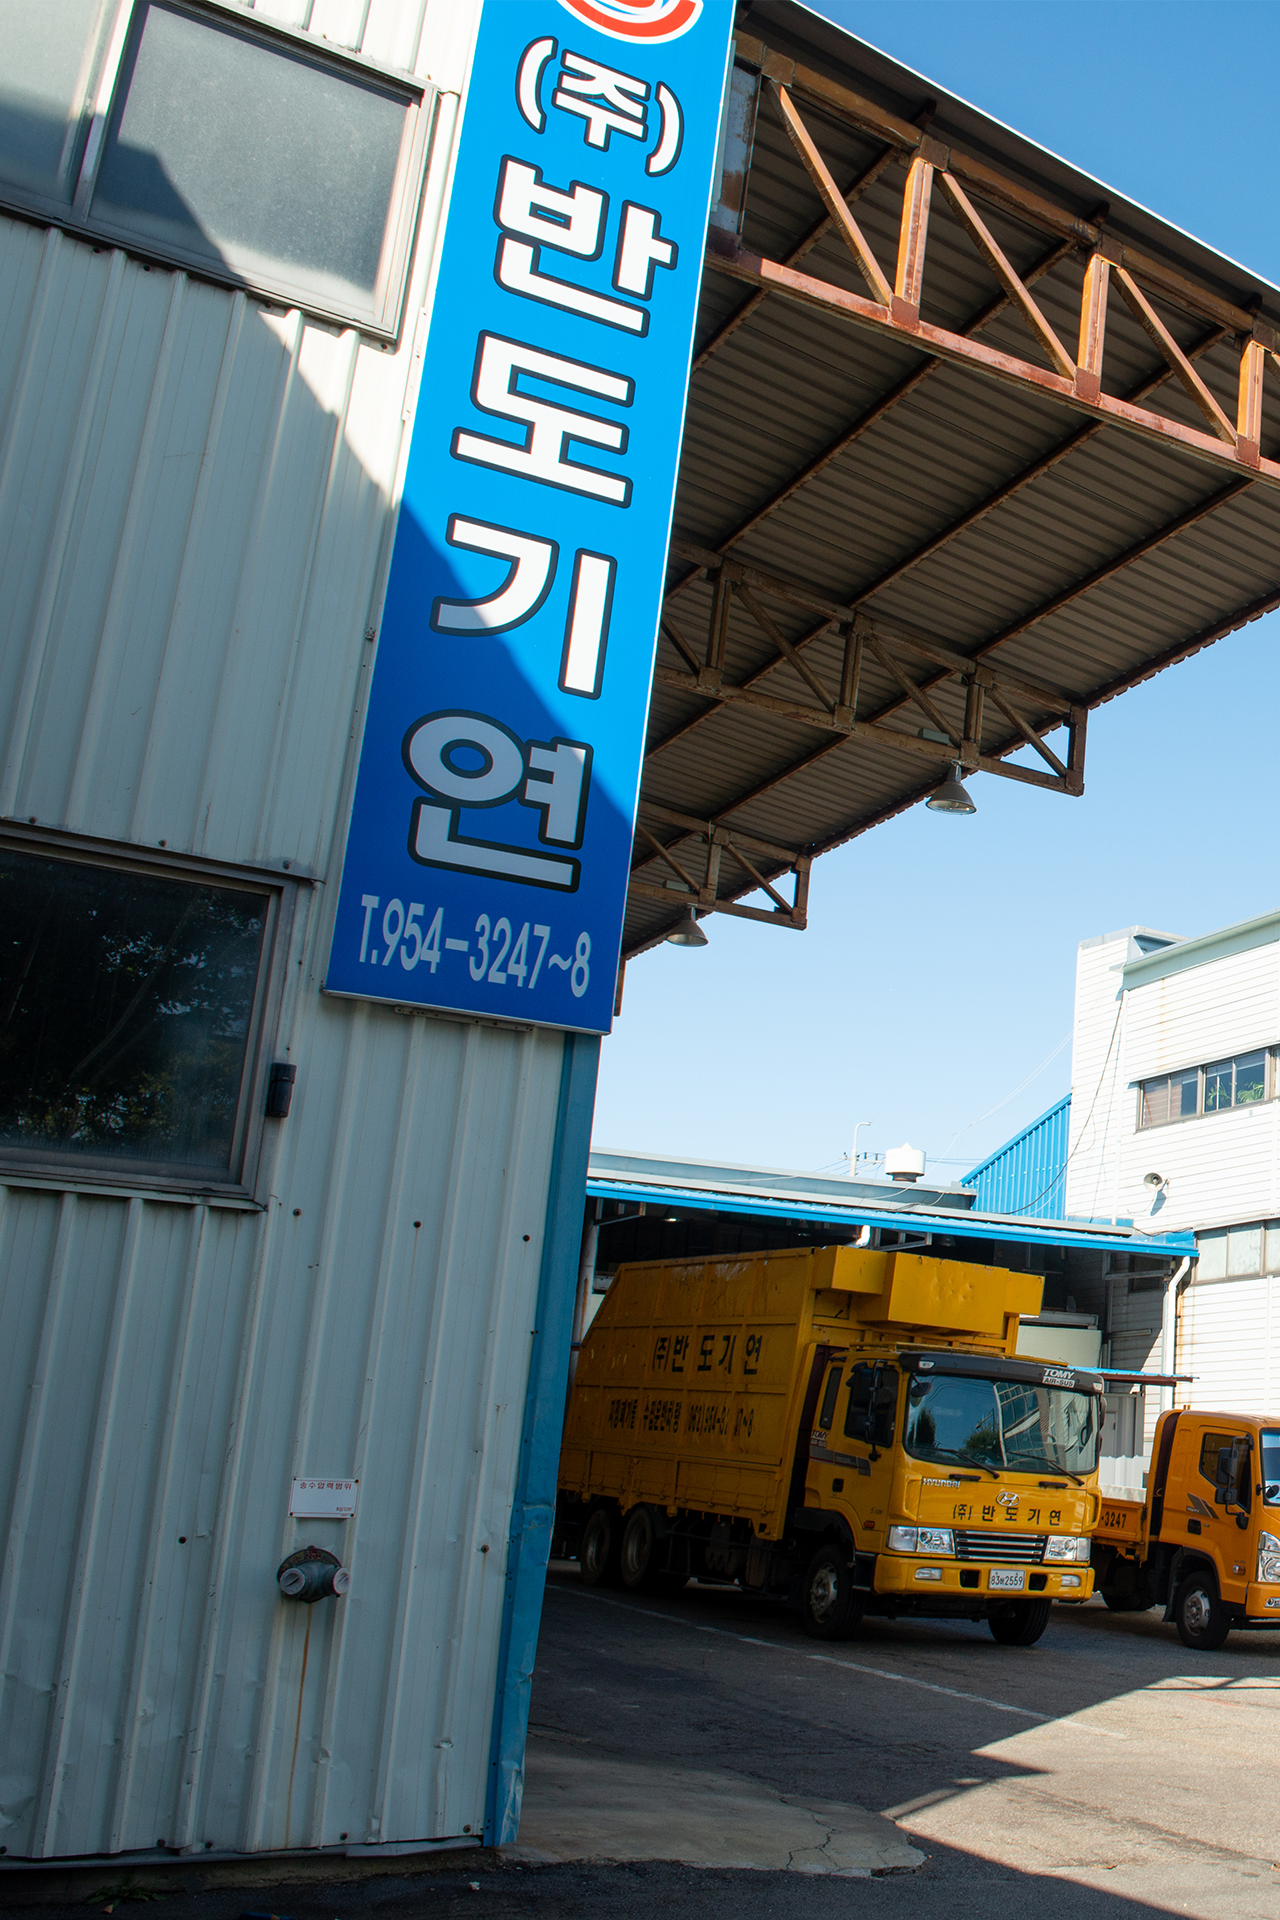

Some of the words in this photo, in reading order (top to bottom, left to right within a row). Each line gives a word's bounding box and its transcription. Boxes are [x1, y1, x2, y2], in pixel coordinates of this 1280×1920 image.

[358, 893, 592, 998] T.954-3247~8
[1043, 1367, 1075, 1380] TOMY
[923, 1478, 961, 1488] HYUNDAI
